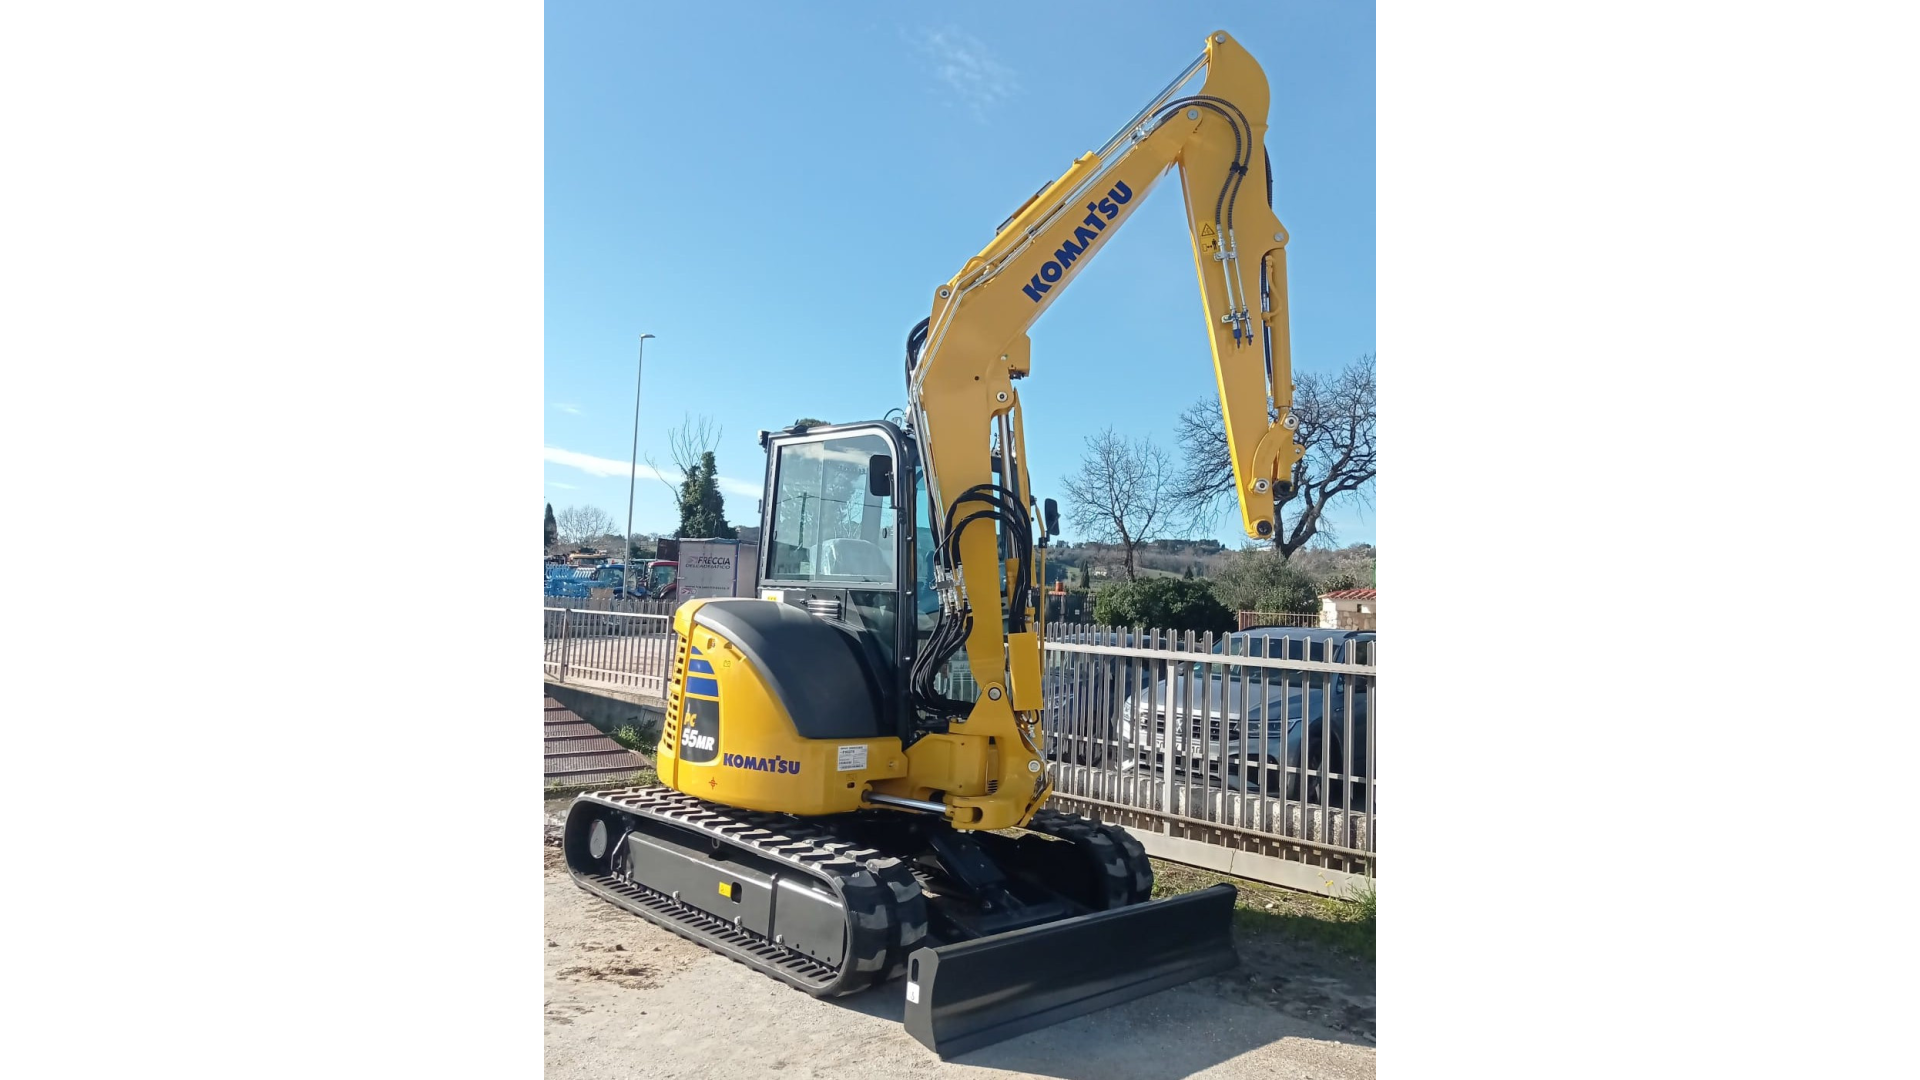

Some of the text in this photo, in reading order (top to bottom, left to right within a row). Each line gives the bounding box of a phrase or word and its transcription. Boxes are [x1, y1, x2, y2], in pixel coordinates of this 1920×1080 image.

[1022, 180, 1133, 303] KOMATSU
[697, 556, 731, 565] FRECCIA
[684, 712, 697, 727] PC
[681, 728, 715, 751] 55MR
[723, 753, 800, 775] KOMATSU
